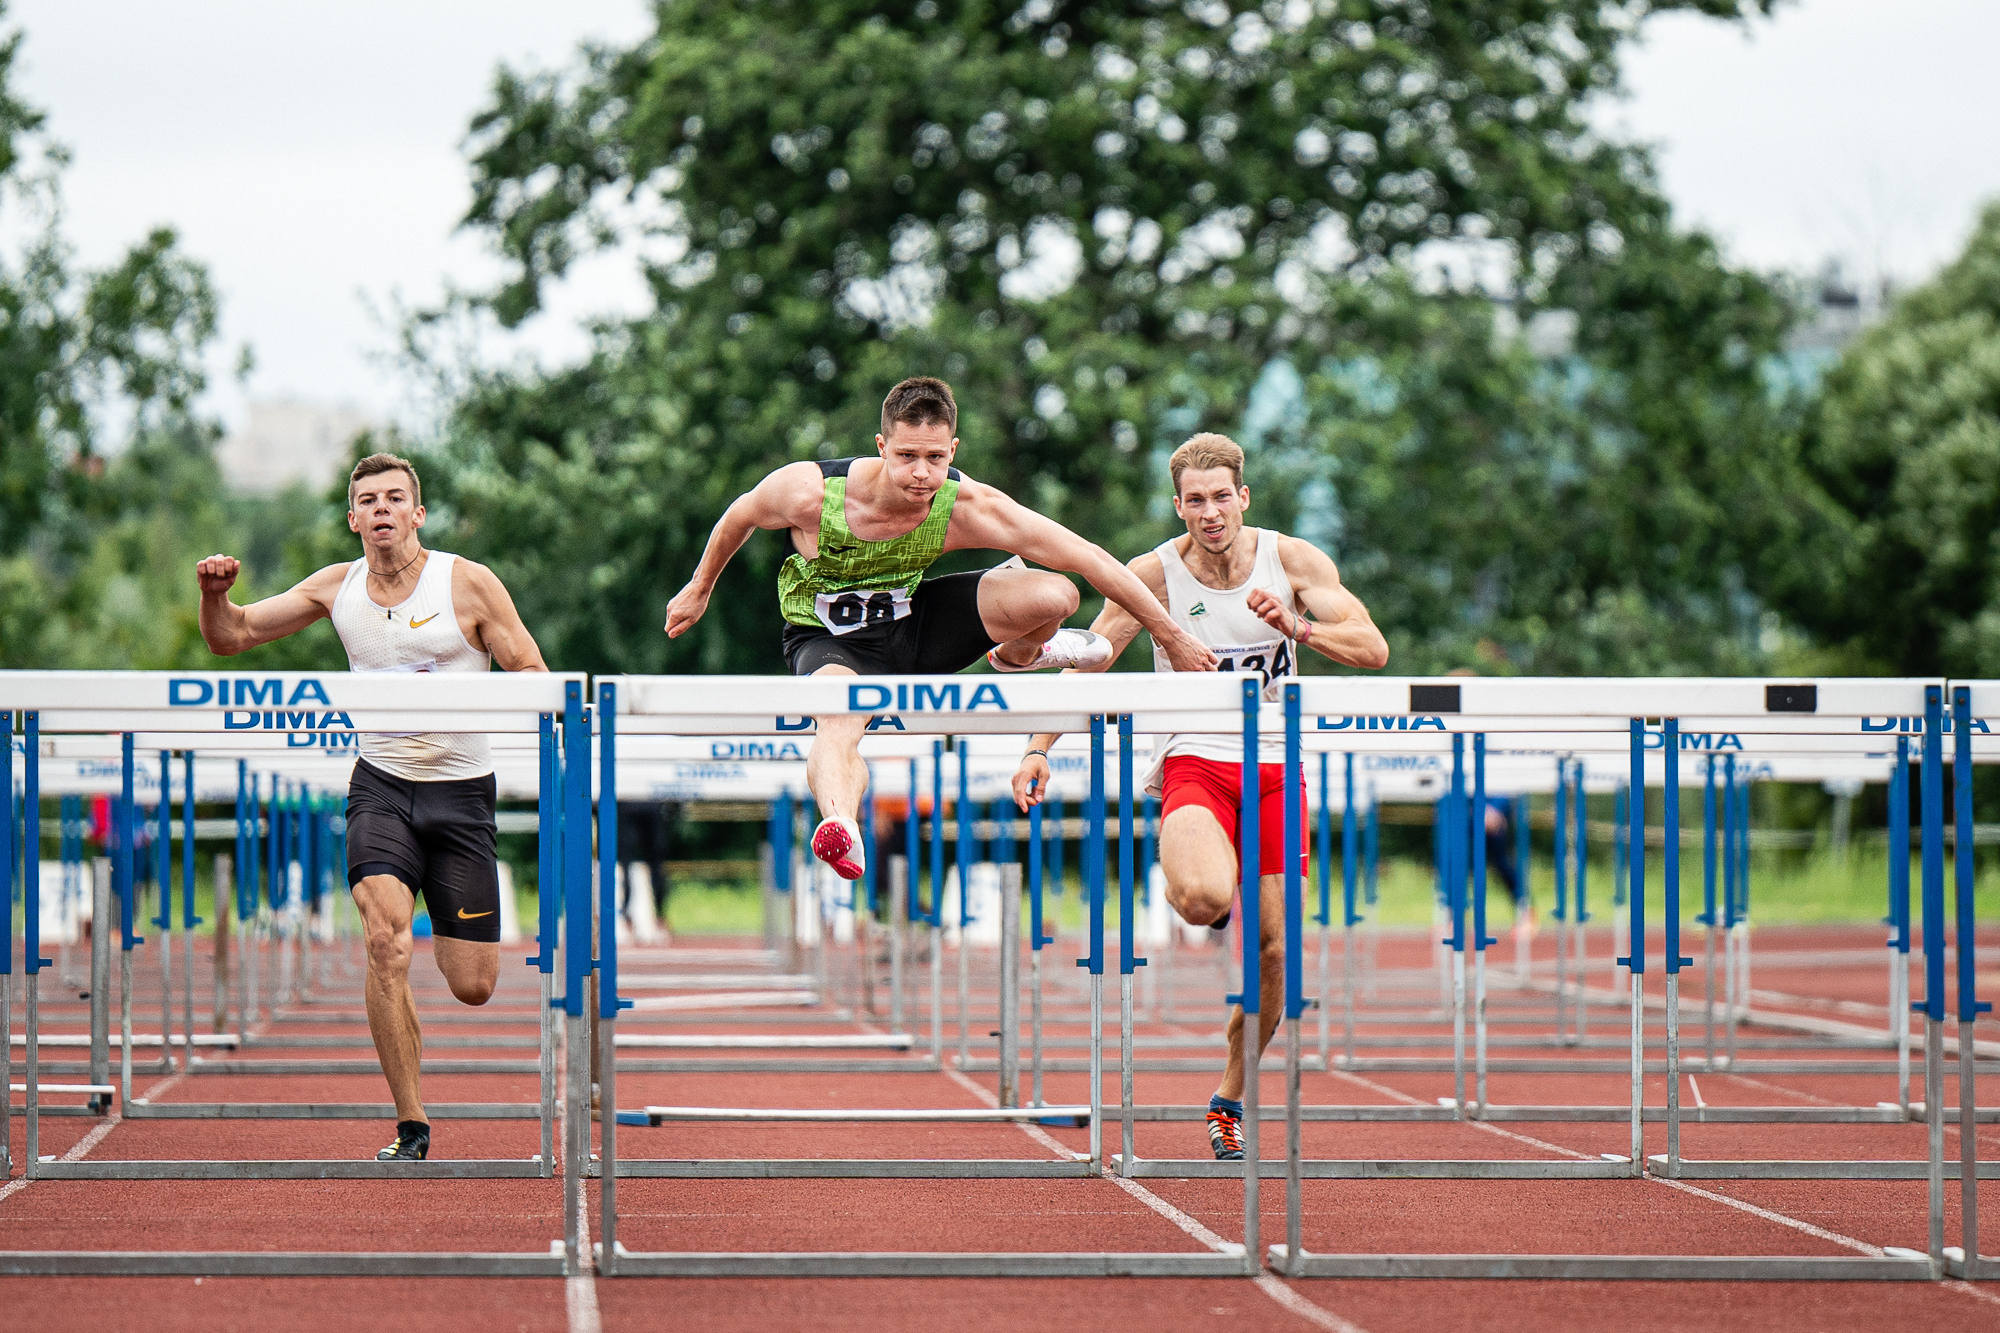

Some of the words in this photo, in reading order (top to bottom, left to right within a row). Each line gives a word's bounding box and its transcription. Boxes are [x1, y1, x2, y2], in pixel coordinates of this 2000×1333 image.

[169, 679, 331, 706] DIMA
[848, 684, 1009, 711] DIMA
[224, 710, 355, 730] DIMA
[776, 714, 906, 731] DA
[1317, 716, 1446, 730] DIMA
[287, 733, 359, 747] DIM
[1643, 731, 1743, 750] DMA
[711, 743, 802, 758] DIMA
